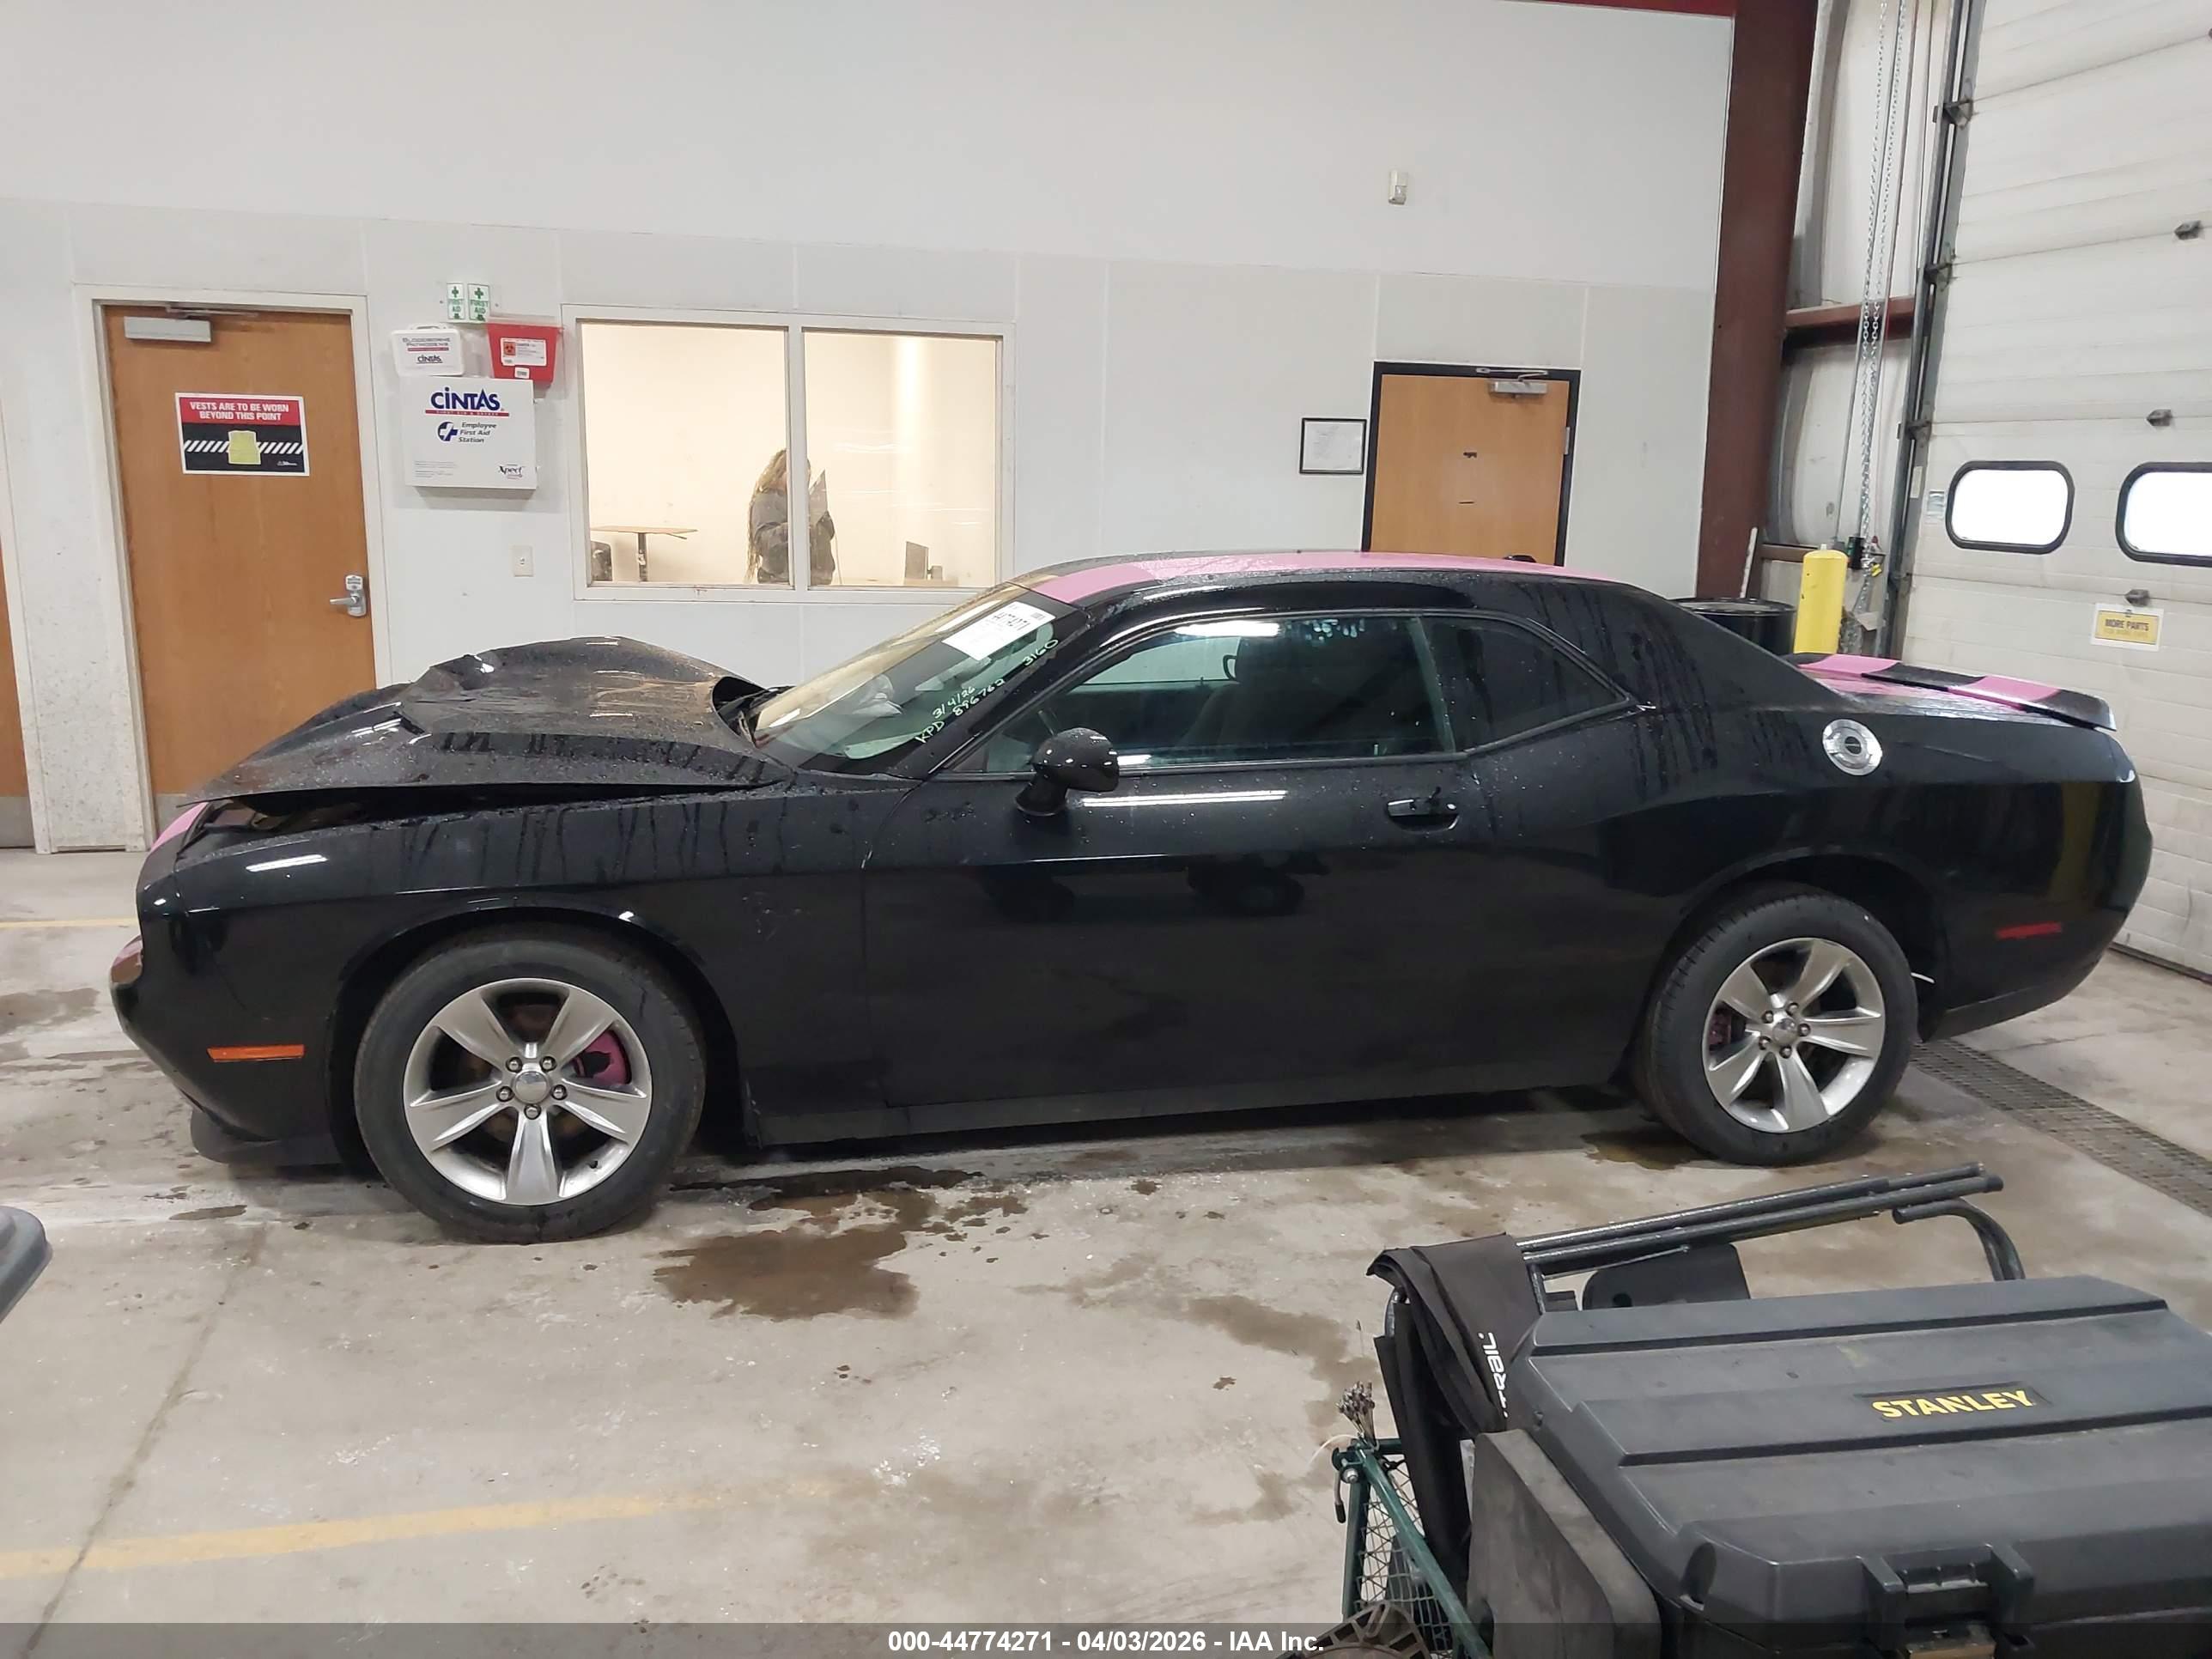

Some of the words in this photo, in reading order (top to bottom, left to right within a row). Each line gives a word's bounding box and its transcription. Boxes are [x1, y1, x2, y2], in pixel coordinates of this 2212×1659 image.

[190, 401, 216, 410] VESTS
[219, 402, 235, 411] ARE
[237, 403, 247, 411] TO
[250, 403, 261, 411] BE
[261, 404, 289, 412] WORN
[256, 412, 282, 421] POINT
[2105, 618, 2125, 629] MORE
[2126, 620, 2149, 631] PARTS
[1022, 639, 1059, 666] 3160
[1872, 1389, 2034, 1418] STANLEY
